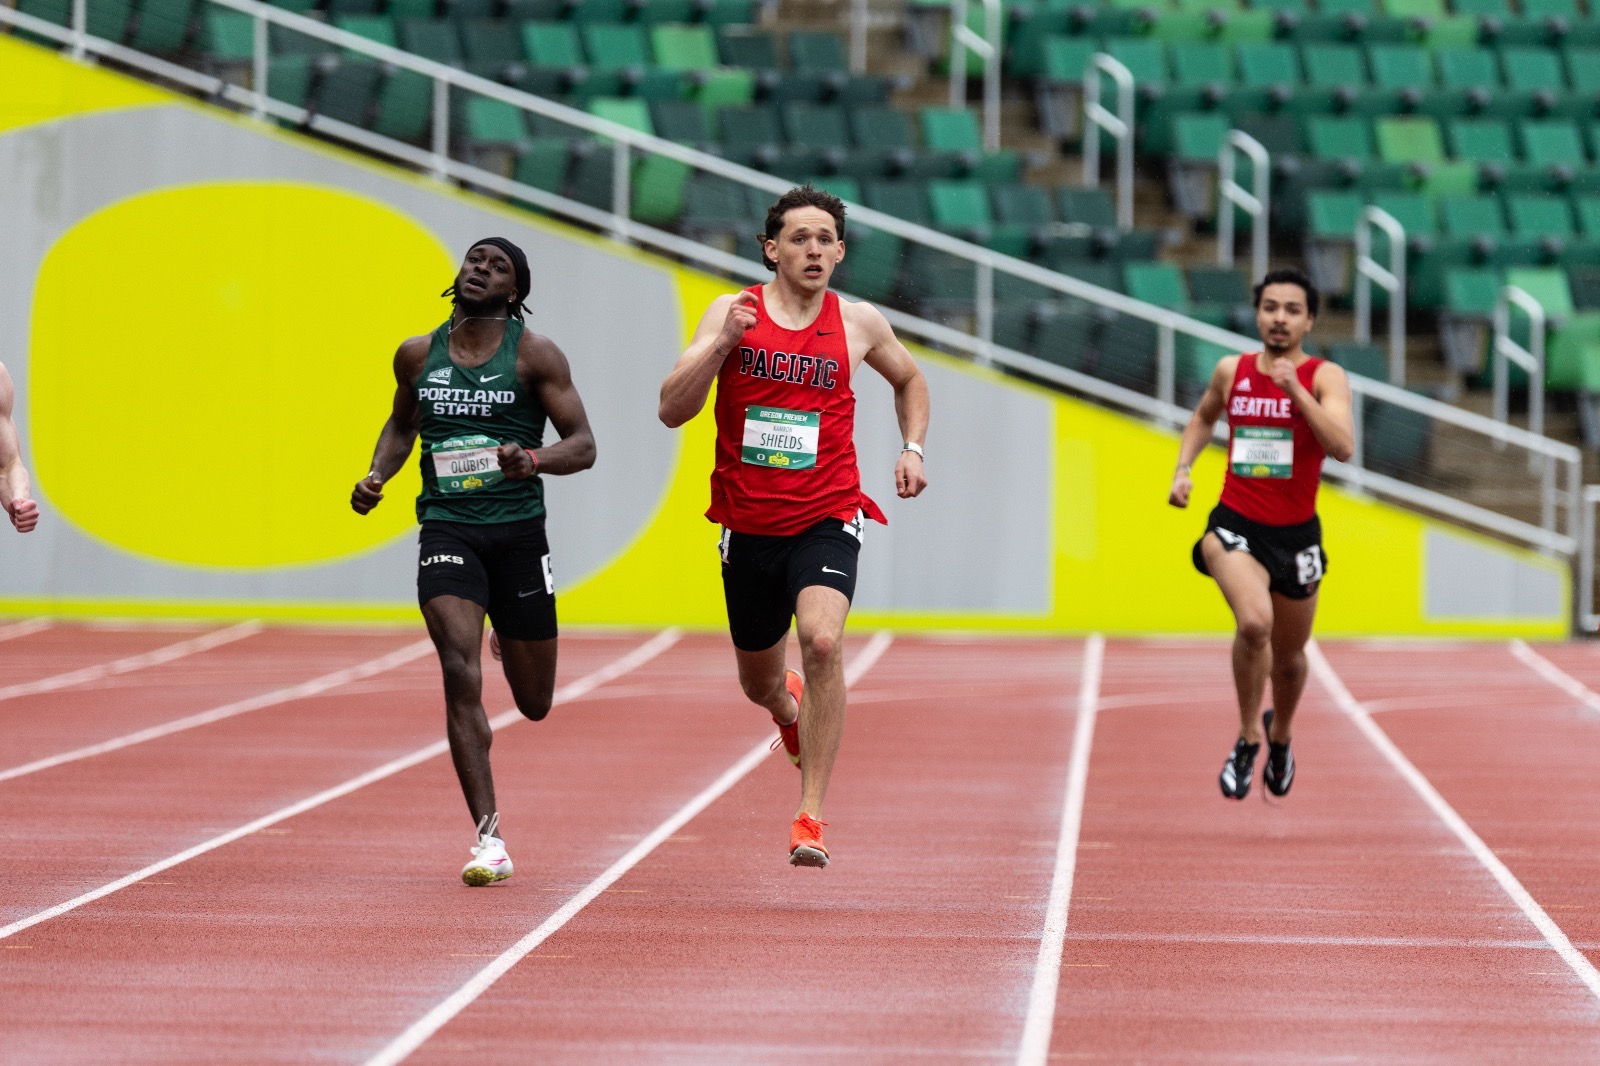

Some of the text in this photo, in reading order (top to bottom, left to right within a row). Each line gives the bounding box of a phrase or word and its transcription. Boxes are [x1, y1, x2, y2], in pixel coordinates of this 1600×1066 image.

[739, 347, 838, 389] PACIFIC
[418, 388, 515, 404] PORTLAND
[433, 402, 492, 417] STATE
[1230, 396, 1291, 418] SEATTLE
[760, 411, 783, 420] OREGON
[783, 413, 808, 422] PREVIEW
[760, 433, 803, 450] SHIELDS
[451, 458, 489, 474] OLUBISI
[1303, 551, 1317, 579] 3
